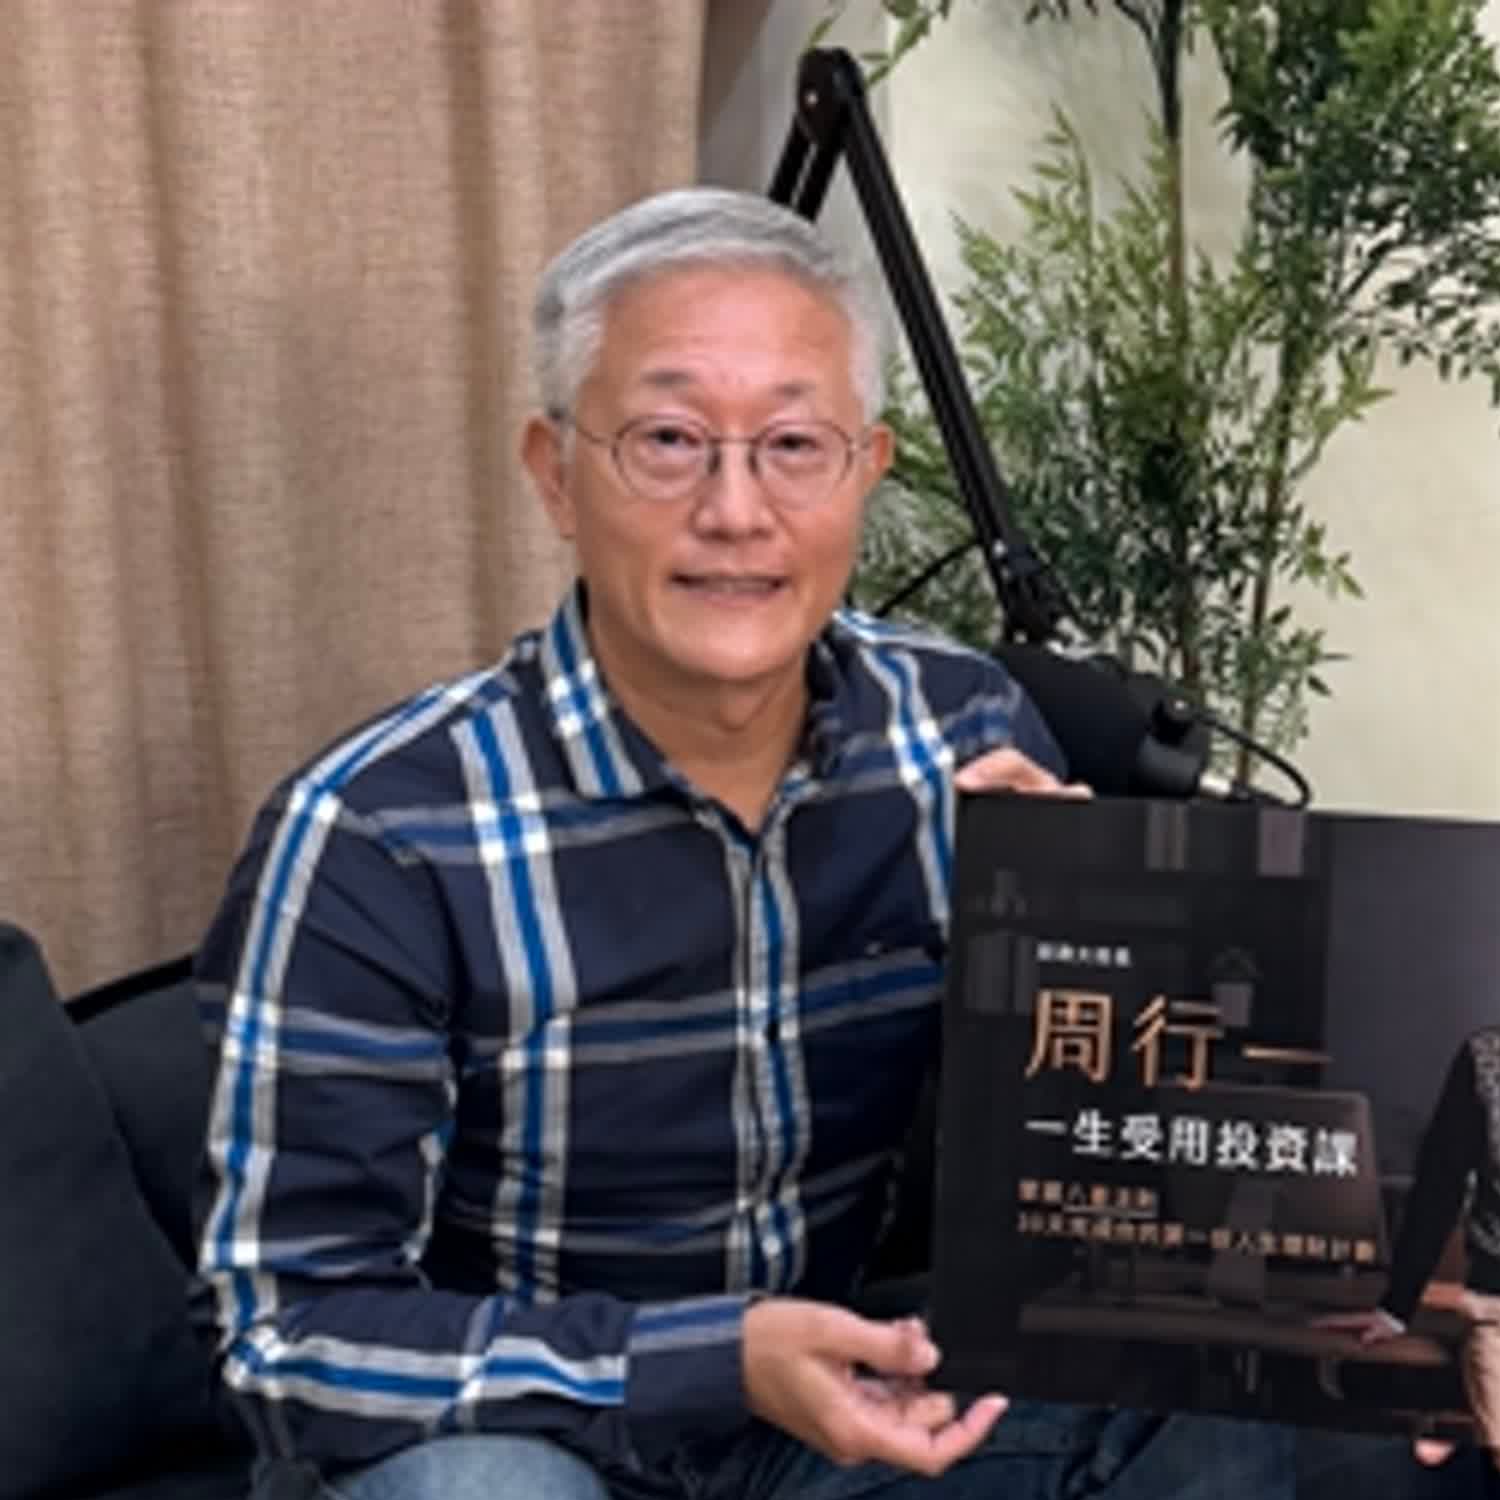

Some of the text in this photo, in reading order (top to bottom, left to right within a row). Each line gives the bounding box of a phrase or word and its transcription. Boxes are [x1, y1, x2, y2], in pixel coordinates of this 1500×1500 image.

[1025, 988, 1333, 1091] 周行一
[1025, 1108, 1357, 1175] 一生受用投資課
